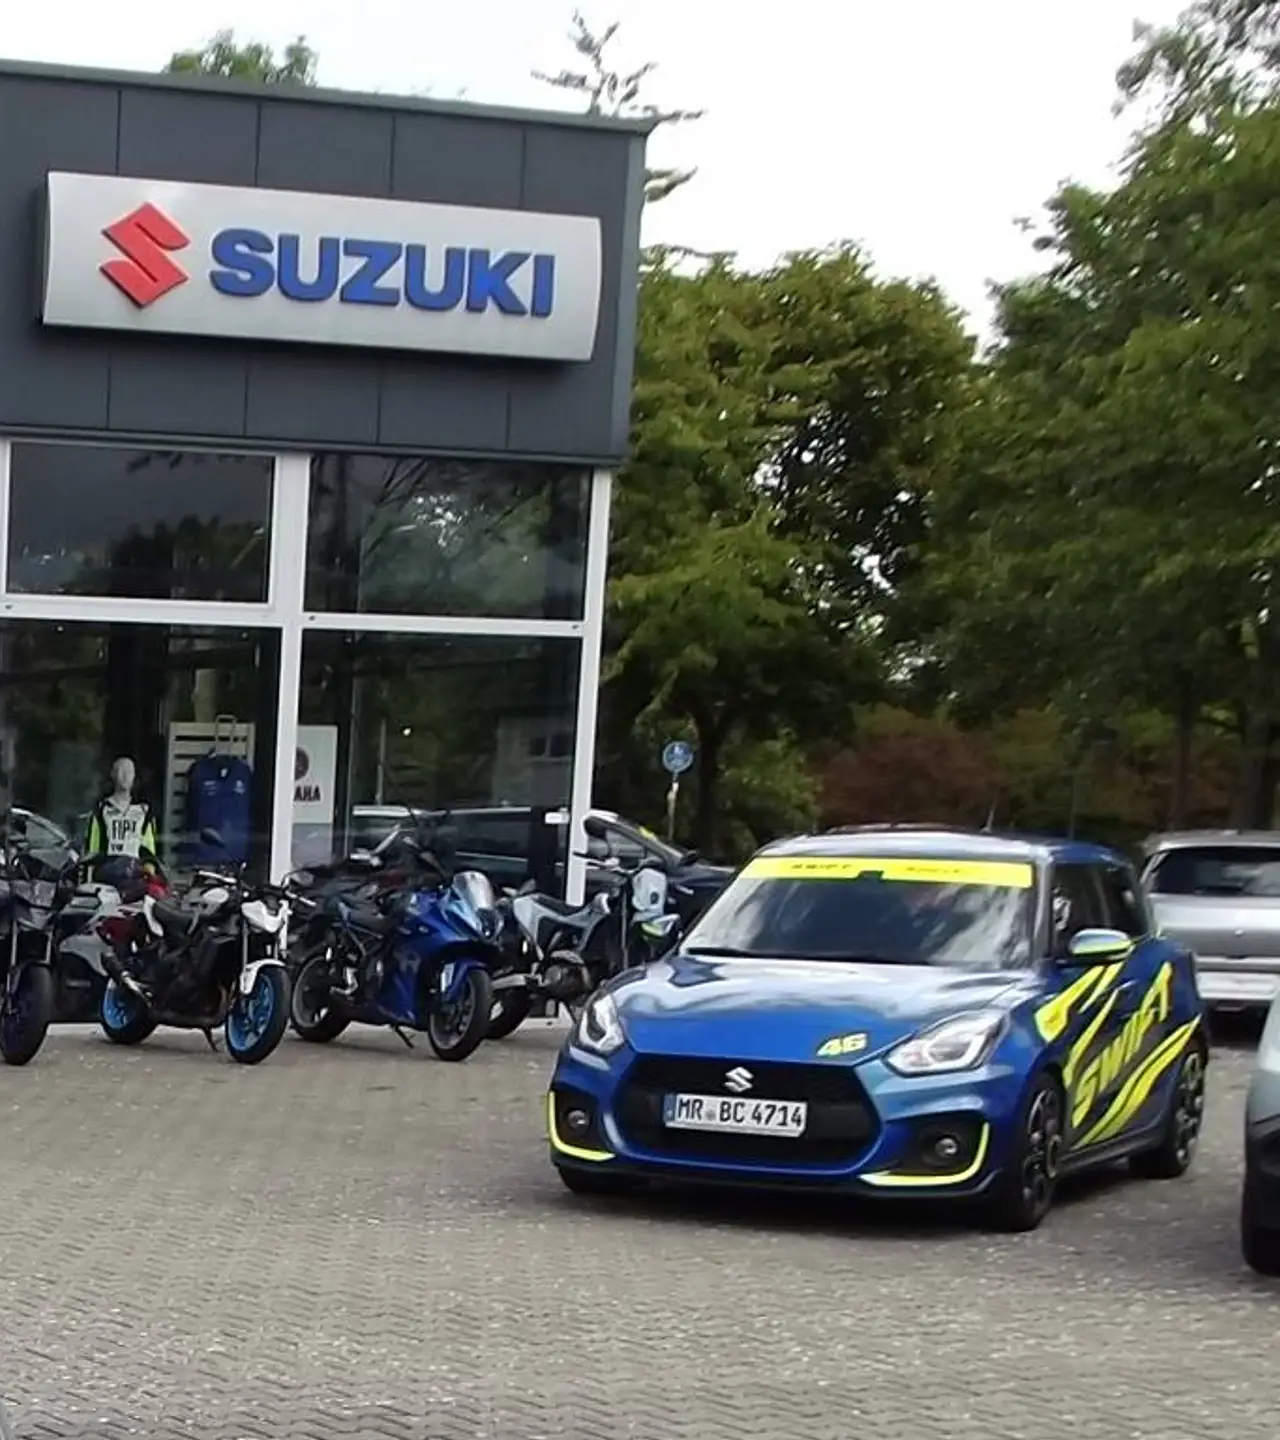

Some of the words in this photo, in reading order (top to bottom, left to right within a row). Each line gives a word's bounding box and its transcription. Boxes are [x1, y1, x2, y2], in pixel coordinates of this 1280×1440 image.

[208, 227, 556, 319] SUZUKI
[294, 785, 321, 802] AHA
[677, 1098, 703, 1121] MR
[719, 1101, 745, 1124] BC
[751, 1104, 803, 1127] 4714
